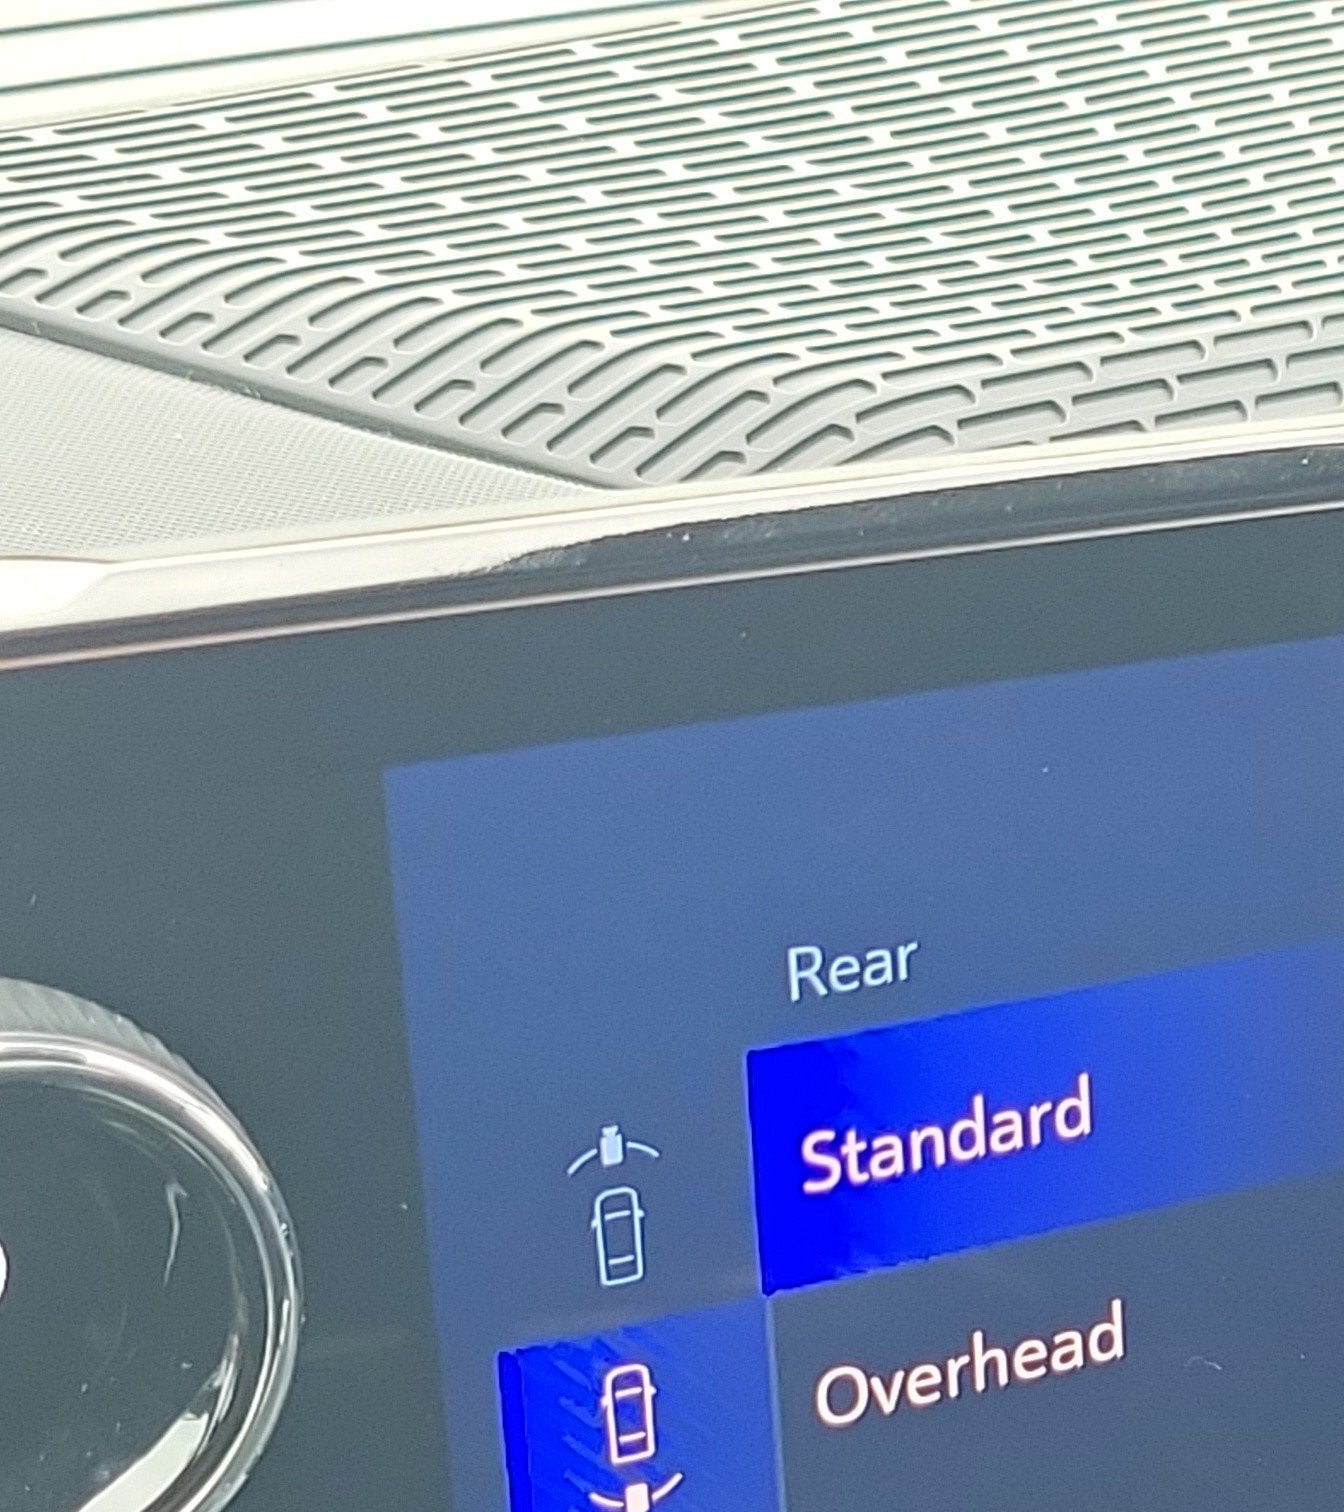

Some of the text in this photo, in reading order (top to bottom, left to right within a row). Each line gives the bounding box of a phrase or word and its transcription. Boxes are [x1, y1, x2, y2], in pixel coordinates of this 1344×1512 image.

[787, 941, 918, 1001] Rear
[801, 1071, 1094, 1195] Standard
[815, 1299, 1126, 1426] Overhead
